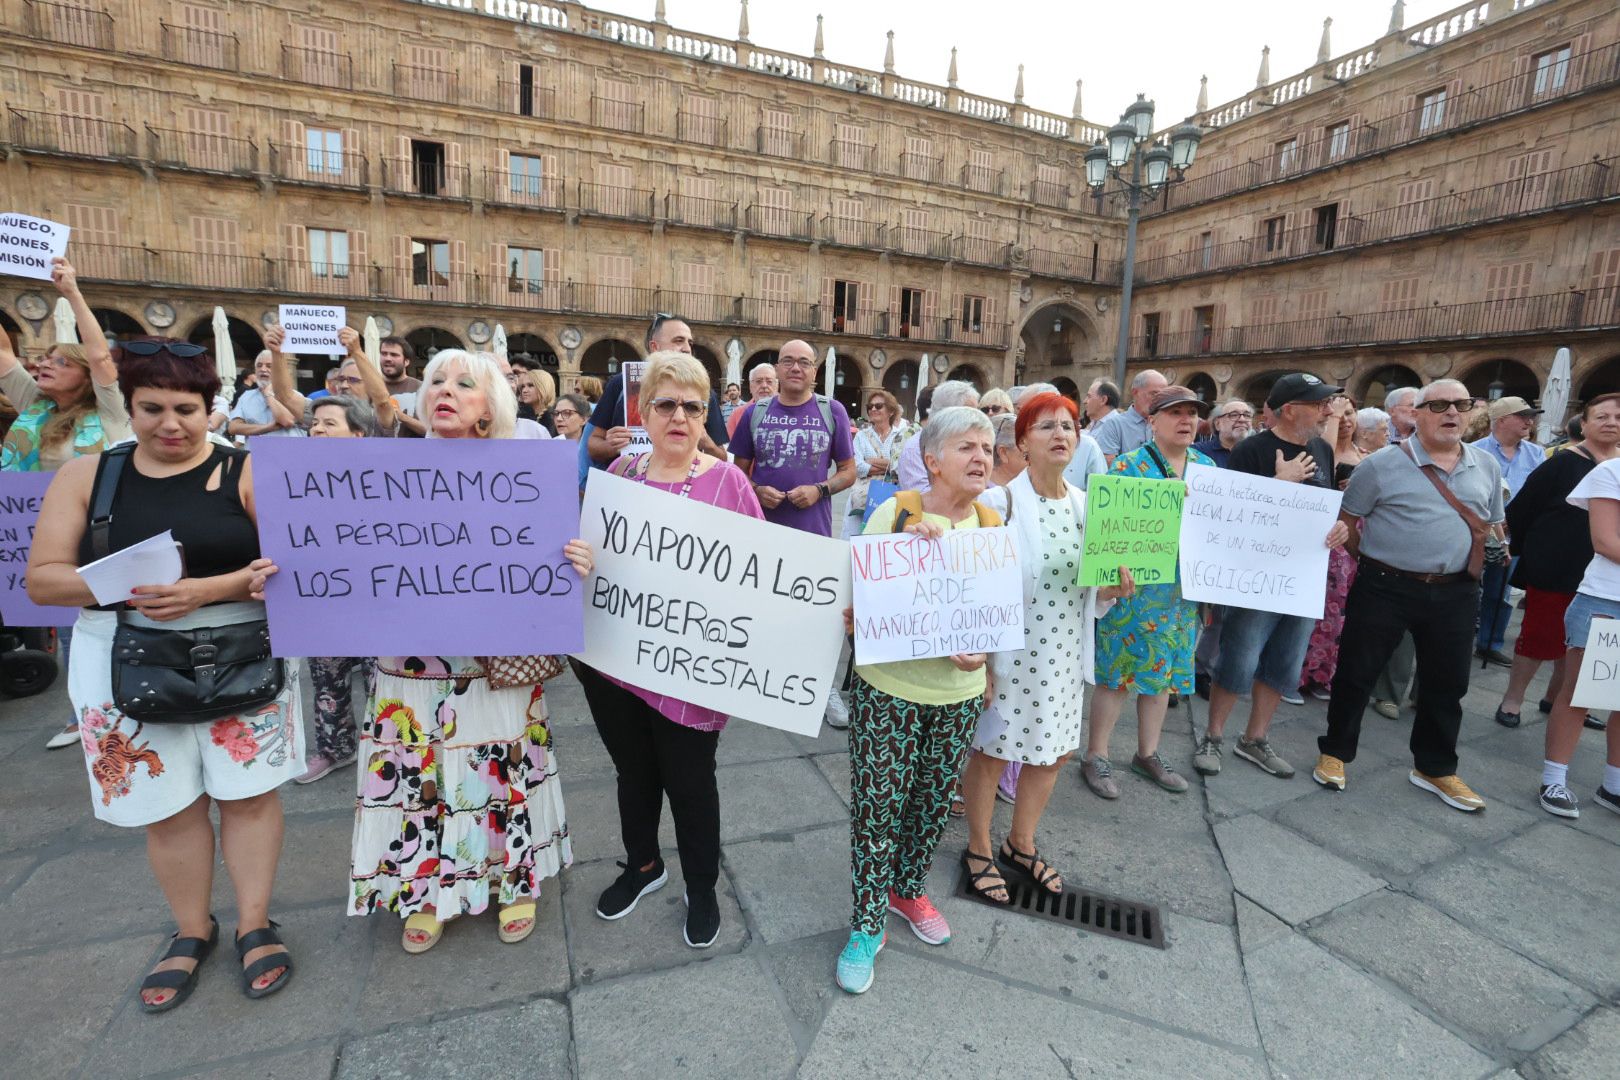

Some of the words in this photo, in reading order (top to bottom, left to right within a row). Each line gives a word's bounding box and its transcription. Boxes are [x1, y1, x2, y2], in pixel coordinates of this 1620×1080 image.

[0, 216, 55, 237] ÑUECO,
[285, 307, 338, 318] MAÑUECO,
[285, 322, 337, 332] QUIÑONES
[762, 414, 798, 426] Made
[802, 415, 821, 427] in
[284, 469, 541, 503] LAMENTAMOS
[1191, 474, 1224, 497] Cada
[0, 496, 45, 514] NVE
[1190, 502, 1223, 521] LLEVA
[1227, 508, 1243, 523] LA
[1251, 511, 1281, 527] FIRMA
[288, 523, 320, 548] LA
[336, 519, 472, 547] PÉRDIDA
[491, 526, 535, 546] DE
[1100, 516, 1165, 536] MAÑUECO
[1085, 540, 1129, 556] SUAREZ
[1206, 531, 1221, 545] DE
[1227, 535, 1245, 550] UN
[600, 507, 628, 554] YO
[632, 520, 732, 582] APOYO
[739, 553, 759, 589] A
[772, 557, 839, 606] L@S
[852, 536, 946, 582] NUESTRA
[293, 569, 352, 598] LOS
[371, 563, 573, 597] FALLECIDOS
[1185, 560, 1297, 596] NEGLIGENTE
[912, 577, 977, 606] ARDE
[592, 576, 753, 648] BOMBER@S
[950, 603, 1021, 632] QUIÑONES
[1597, 632, 1620, 648] MA
[637, 639, 818, 706] FORESTALES
